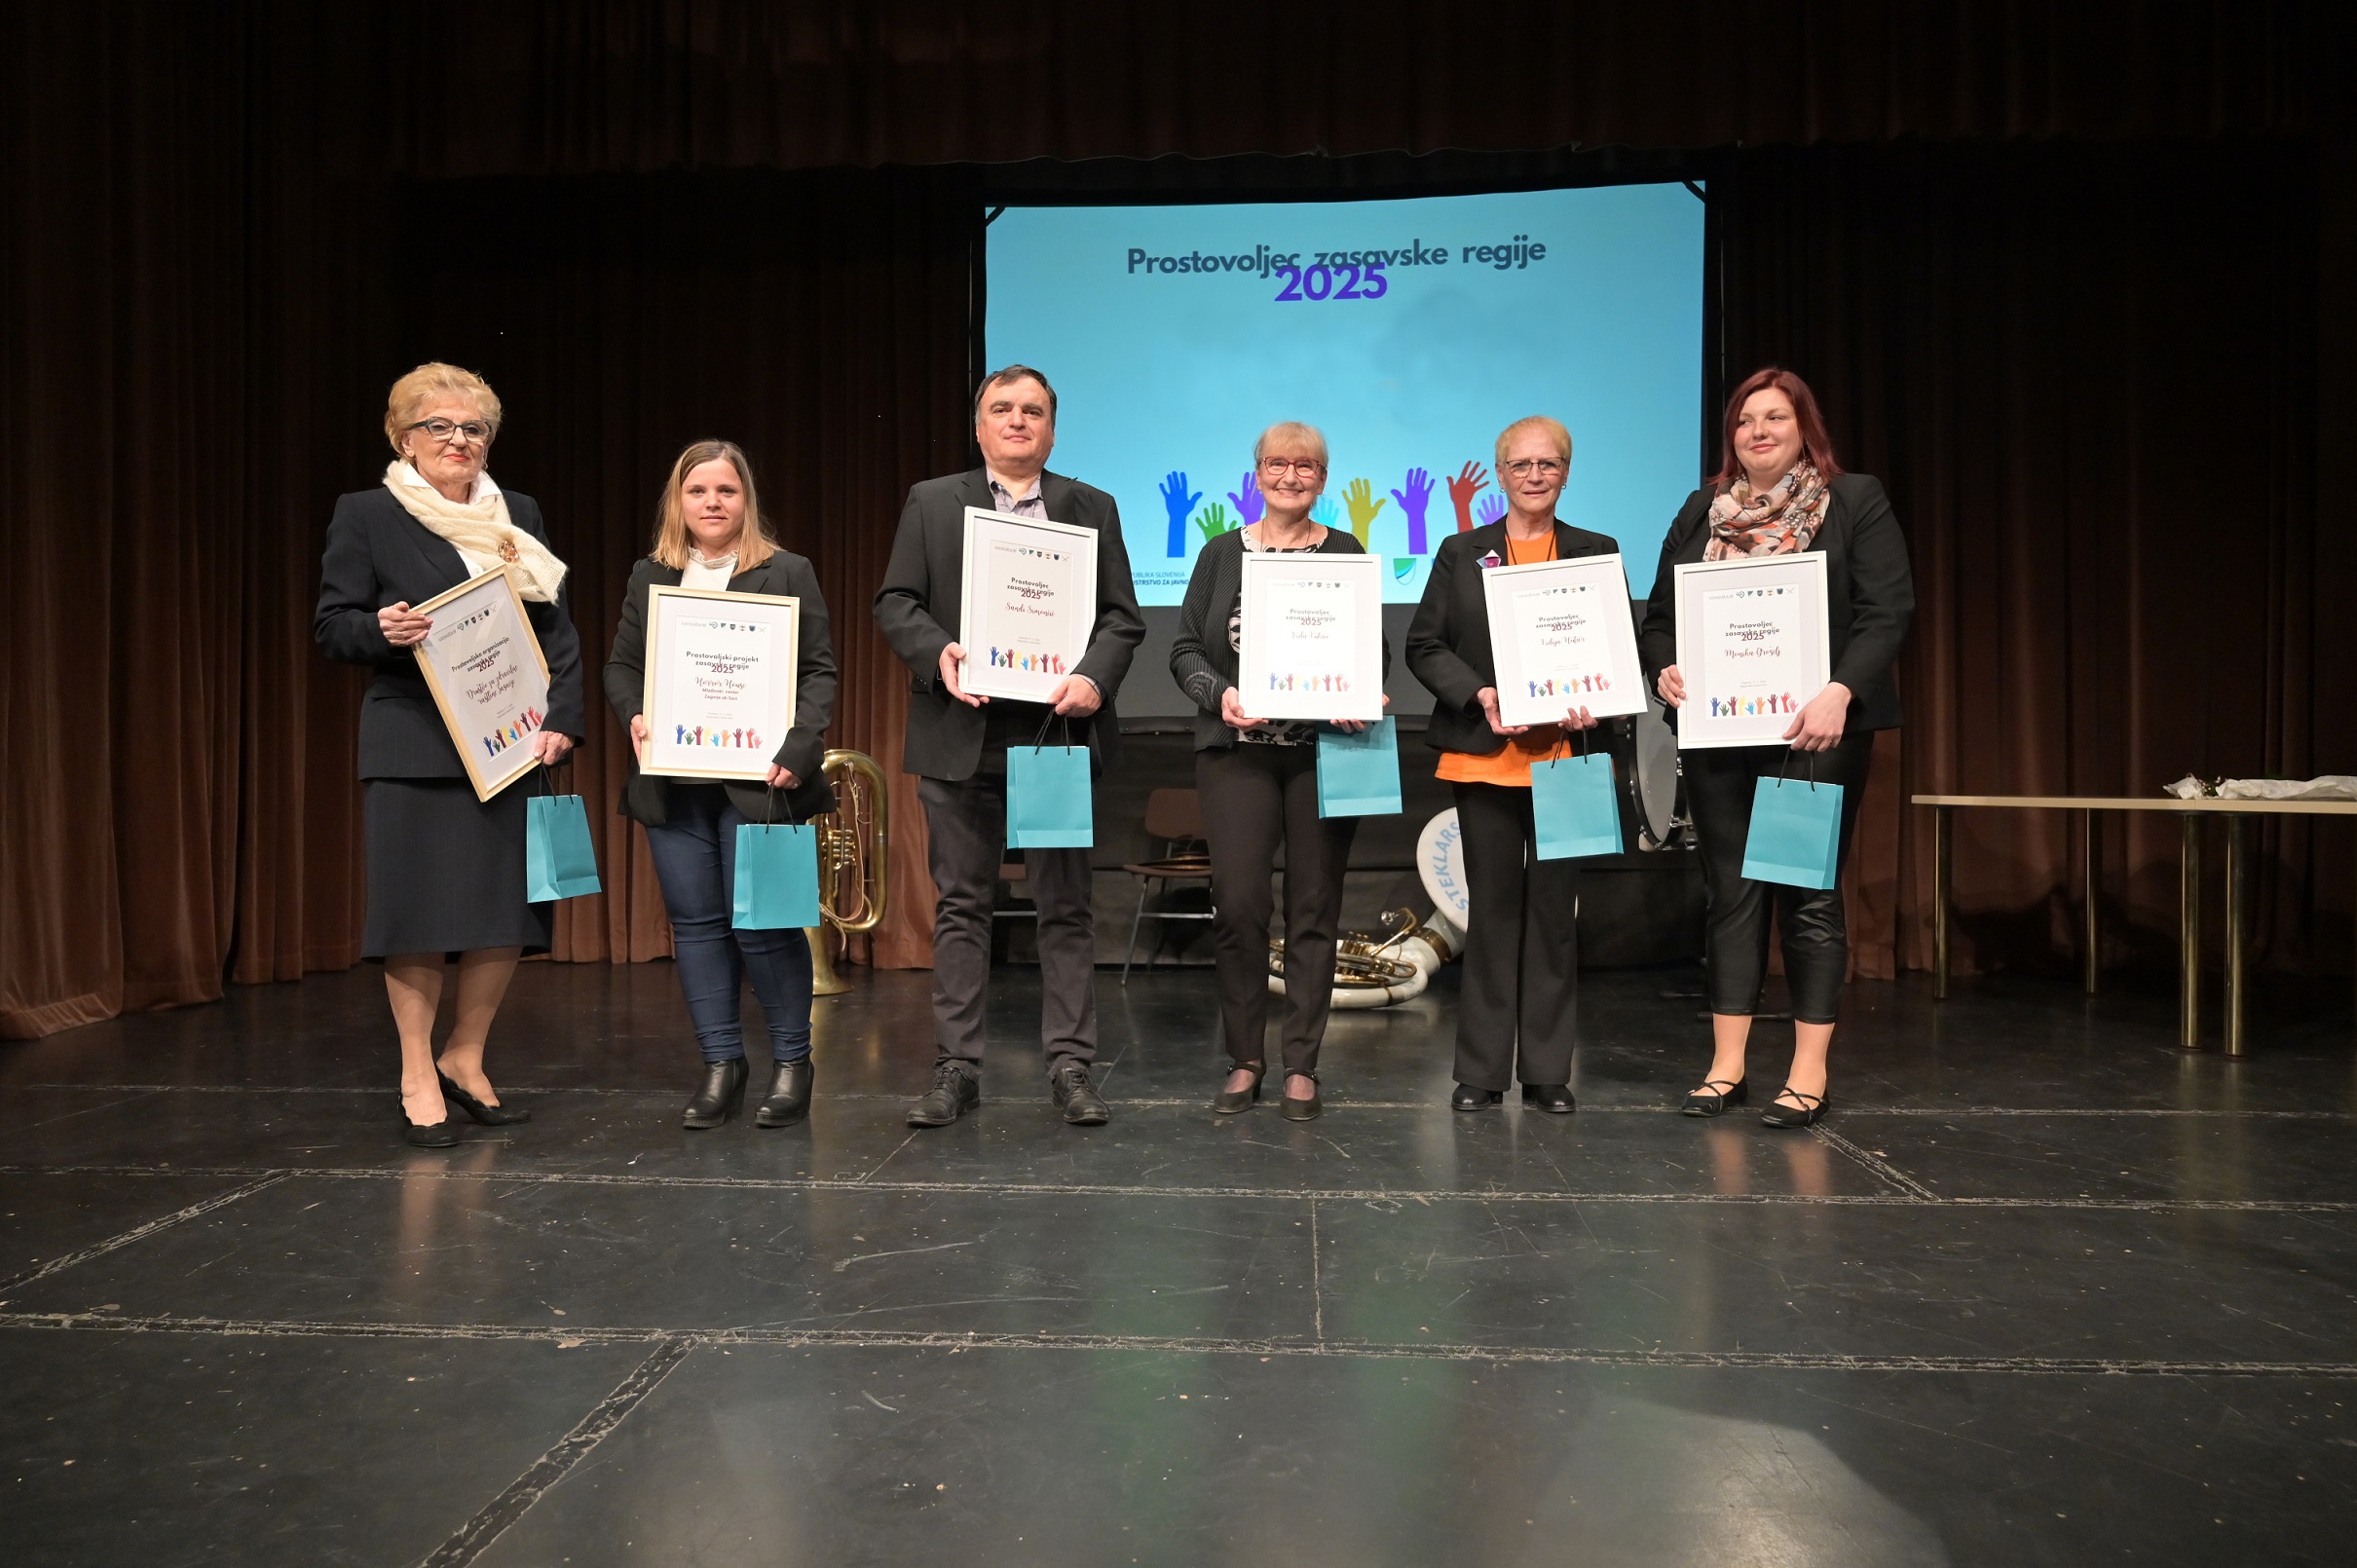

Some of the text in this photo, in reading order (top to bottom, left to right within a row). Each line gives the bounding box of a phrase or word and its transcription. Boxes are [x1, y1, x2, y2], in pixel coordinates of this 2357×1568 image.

[1127, 234, 1547, 279] Prostovoljec zasavske regije
[1274, 261, 1389, 302] 2025
[1011, 578, 1049, 589] Prostovoljec
[1021, 590, 1041, 600] 2025
[1539, 614, 1579, 622] Prostovoljec
[1730, 620, 1773, 629] Prostovoljec
[686, 651, 731, 662] Prostovoljski
[478, 658, 495, 673] 2025
[711, 665, 734, 674] 2025
